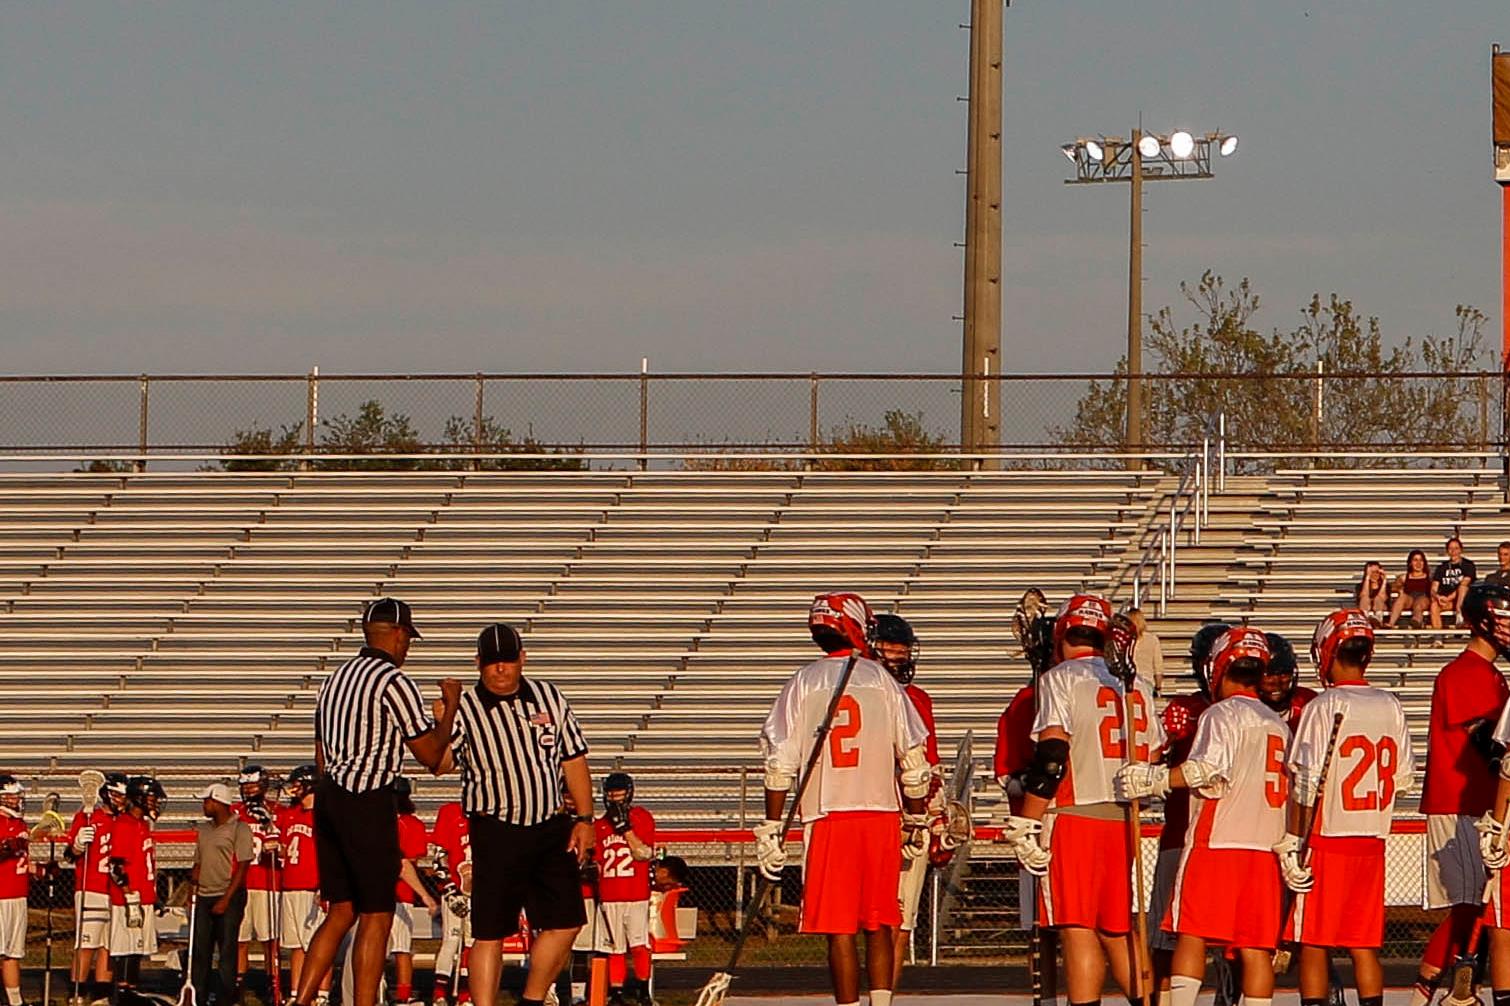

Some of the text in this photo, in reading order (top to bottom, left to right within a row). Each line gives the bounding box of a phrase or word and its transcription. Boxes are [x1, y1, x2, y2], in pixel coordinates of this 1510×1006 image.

[829, 694, 862, 768] 2
[1096, 686, 1149, 762] 22
[1264, 734, 1289, 809] 5
[1339, 735, 1398, 811] 28
[287, 836, 299, 865] 4
[603, 847, 635, 878] 22
